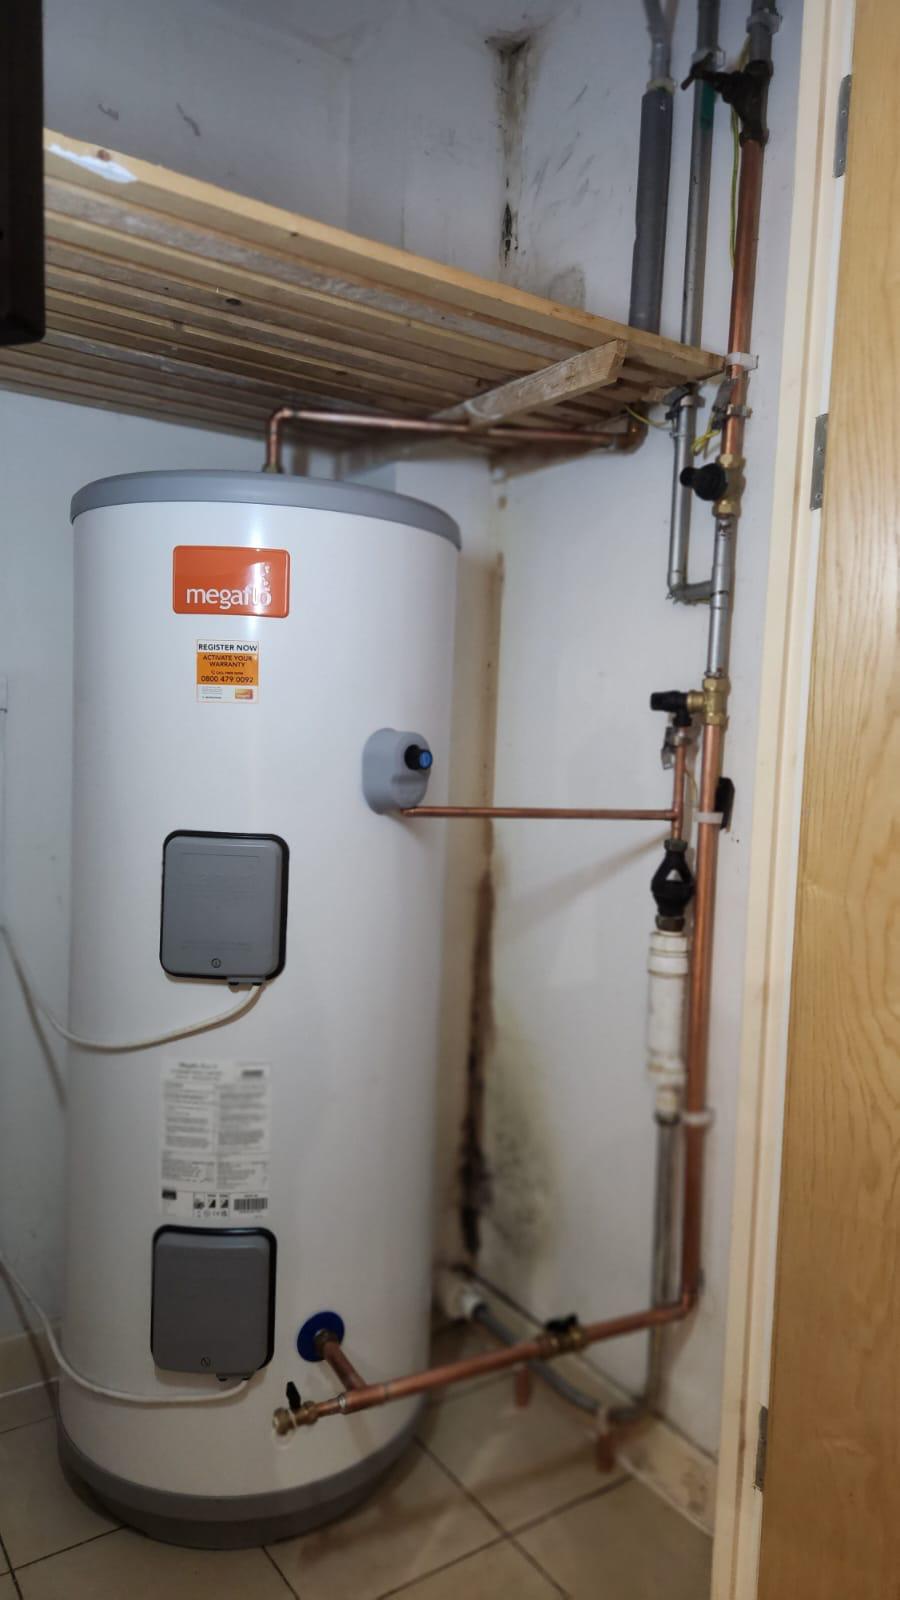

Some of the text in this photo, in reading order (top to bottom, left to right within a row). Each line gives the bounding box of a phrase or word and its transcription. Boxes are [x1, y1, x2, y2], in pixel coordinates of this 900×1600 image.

[186, 584, 272, 610] megaflo
[198, 643, 258, 652] REGISTER NOW
